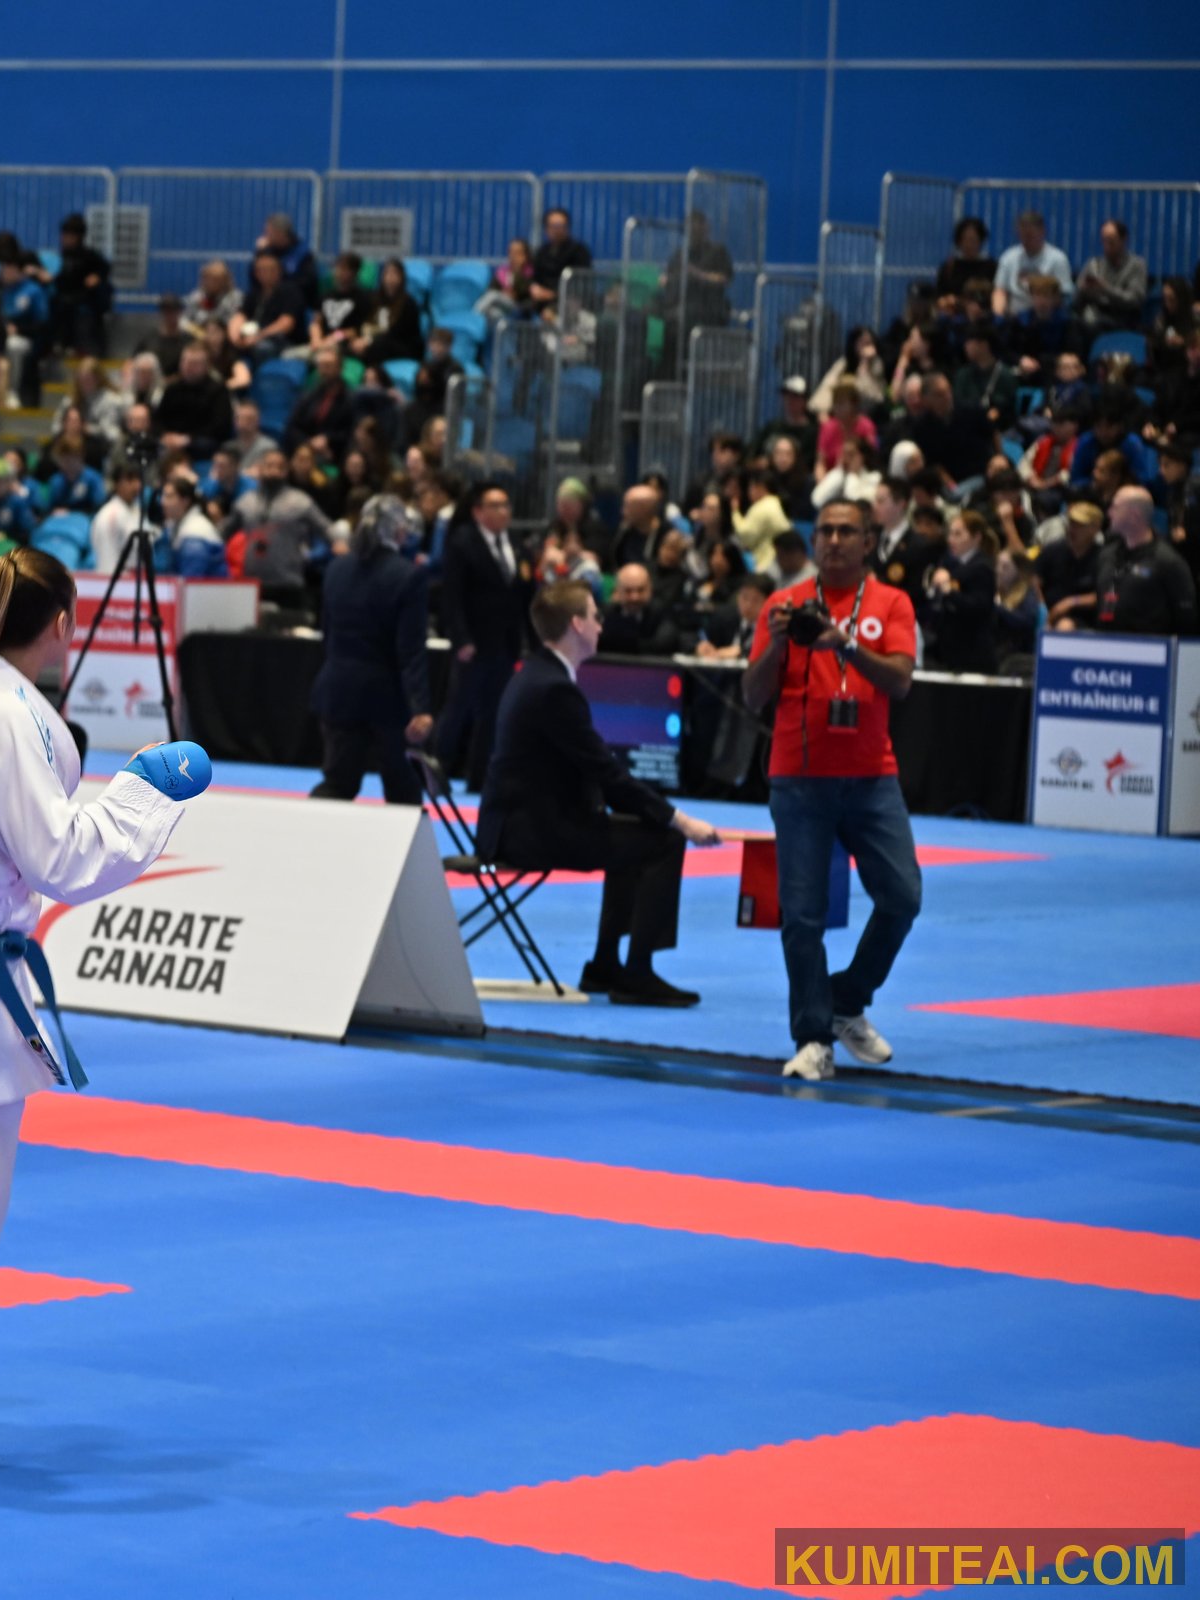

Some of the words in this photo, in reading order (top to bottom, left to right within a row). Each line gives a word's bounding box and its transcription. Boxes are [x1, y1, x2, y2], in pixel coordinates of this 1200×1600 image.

[1072, 667, 1132, 688] COACH
[91, 904, 243, 952] KARATE
[77, 946, 227, 994] CANADA
